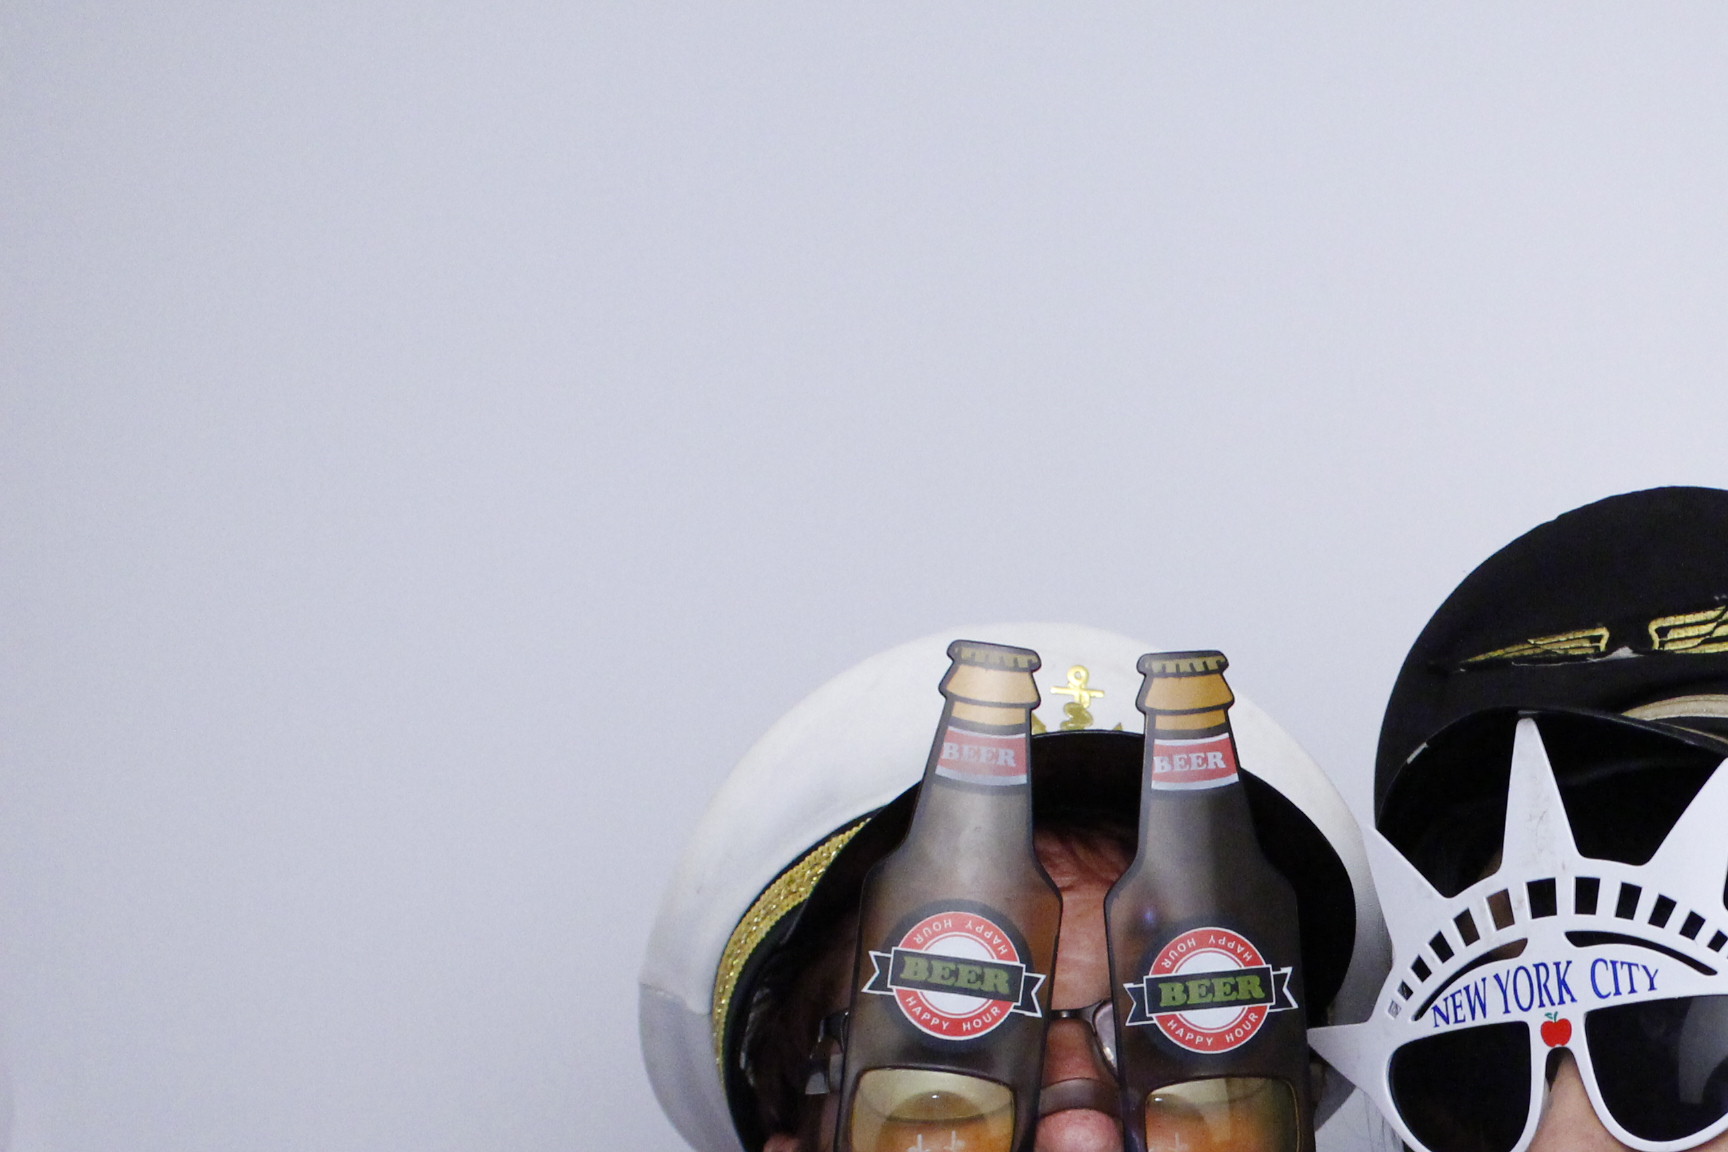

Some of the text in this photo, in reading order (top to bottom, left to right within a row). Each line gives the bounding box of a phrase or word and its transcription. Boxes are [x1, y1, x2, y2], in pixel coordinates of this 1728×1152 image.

[941, 741, 1016, 767] BEER
[1153, 751, 1226, 774] BEER
[913, 919, 1008, 955] HAPPY HOUR
[1161, 935, 1253, 969] HAPPY HOUR
[900, 955, 1010, 995] BEER
[1158, 974, 1266, 1008] BEER
[1431, 958, 1660, 1028] NEW YORK CITY
[905, 996, 1002, 1032] HAPPY HOUR
[1167, 1012, 1259, 1046] HAPPY HOUR
